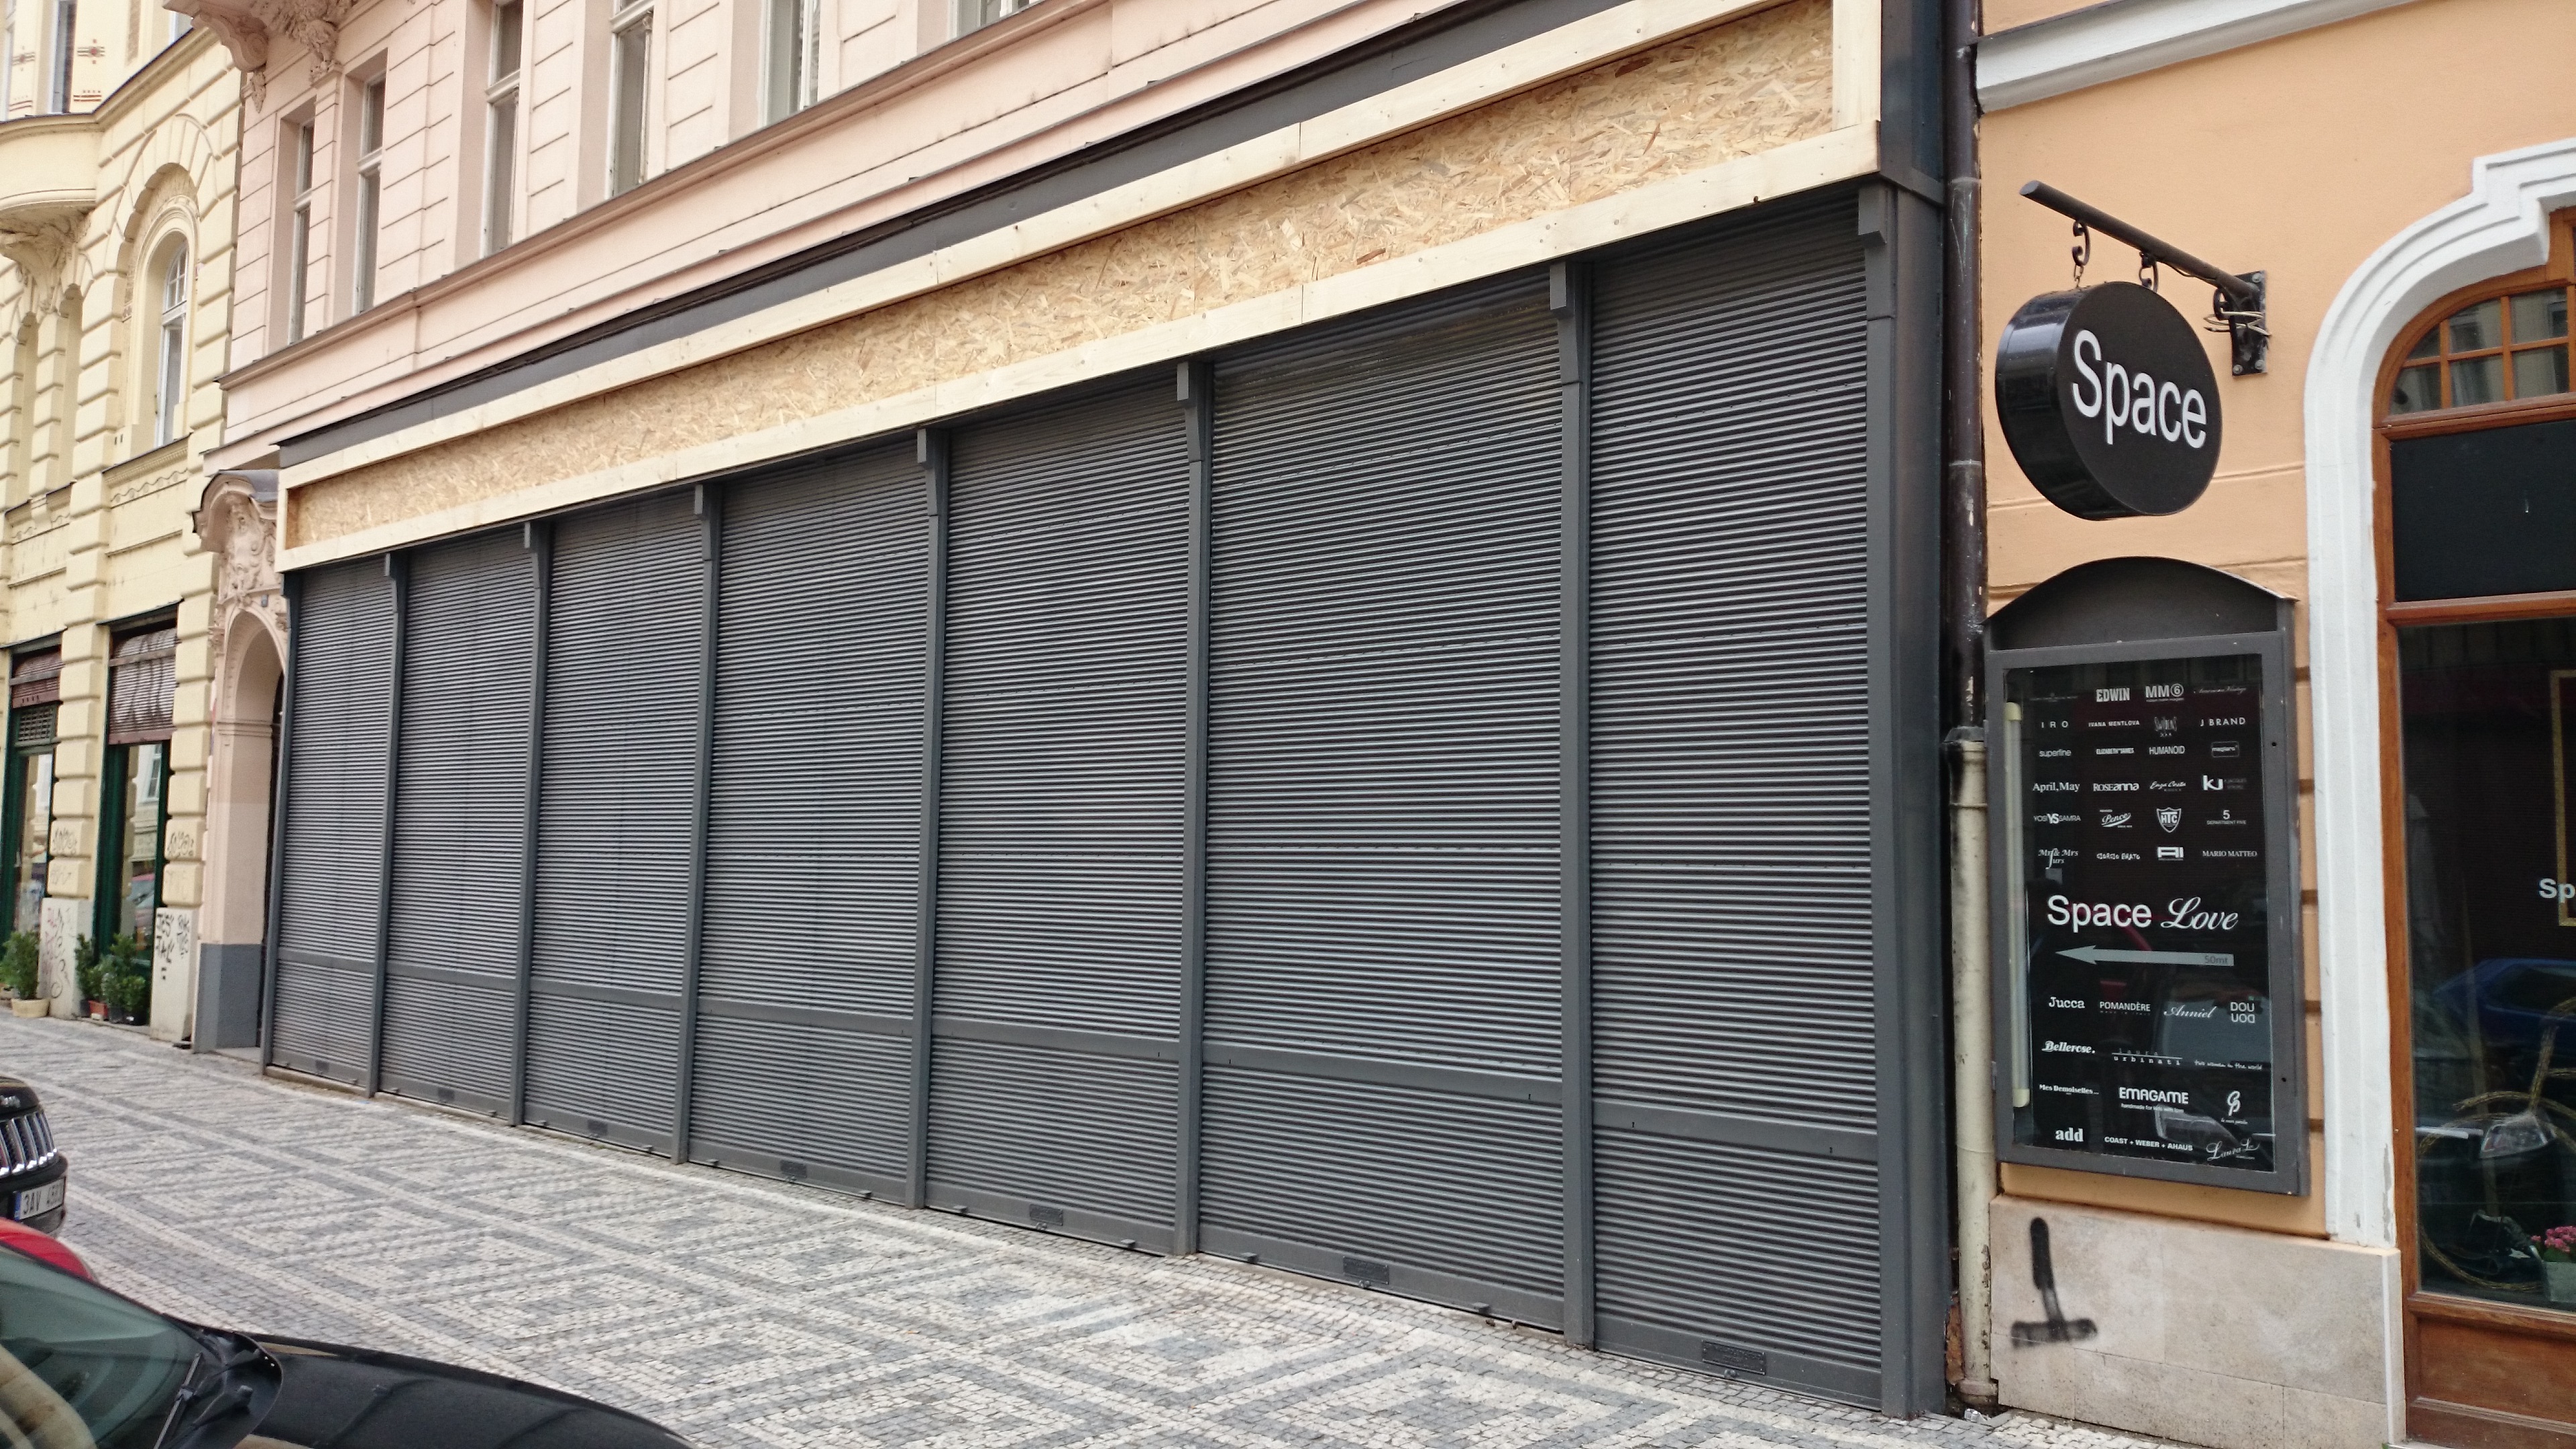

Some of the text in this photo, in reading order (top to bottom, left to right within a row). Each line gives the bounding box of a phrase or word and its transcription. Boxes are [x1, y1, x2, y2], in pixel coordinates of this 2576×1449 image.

[2072, 329, 2207, 449] Space
[2096, 688, 2131, 702] EDWIN
[2200, 716, 2246, 727] J BRAND
[2149, 745, 2186, 755] HUMANOID
[2161, 811, 2178, 824] HTC
[2222, 809, 2231, 820] 5
[2538, 877, 2576, 904] Sp
[2047, 894, 2239, 933] Space Love
[2204, 954, 2229, 964] 50mt
[2048, 996, 2086, 1009] Jucca
[2230, 1002, 2255, 1012] DOU
[2039, 1083, 2053, 1091] Mes
[2055, 1127, 2084, 1142] add
[2104, 1136, 2129, 1144] COAST
[2135, 1139, 2160, 1148] WEBER
[2167, 1142, 2194, 1151] AHAUS
